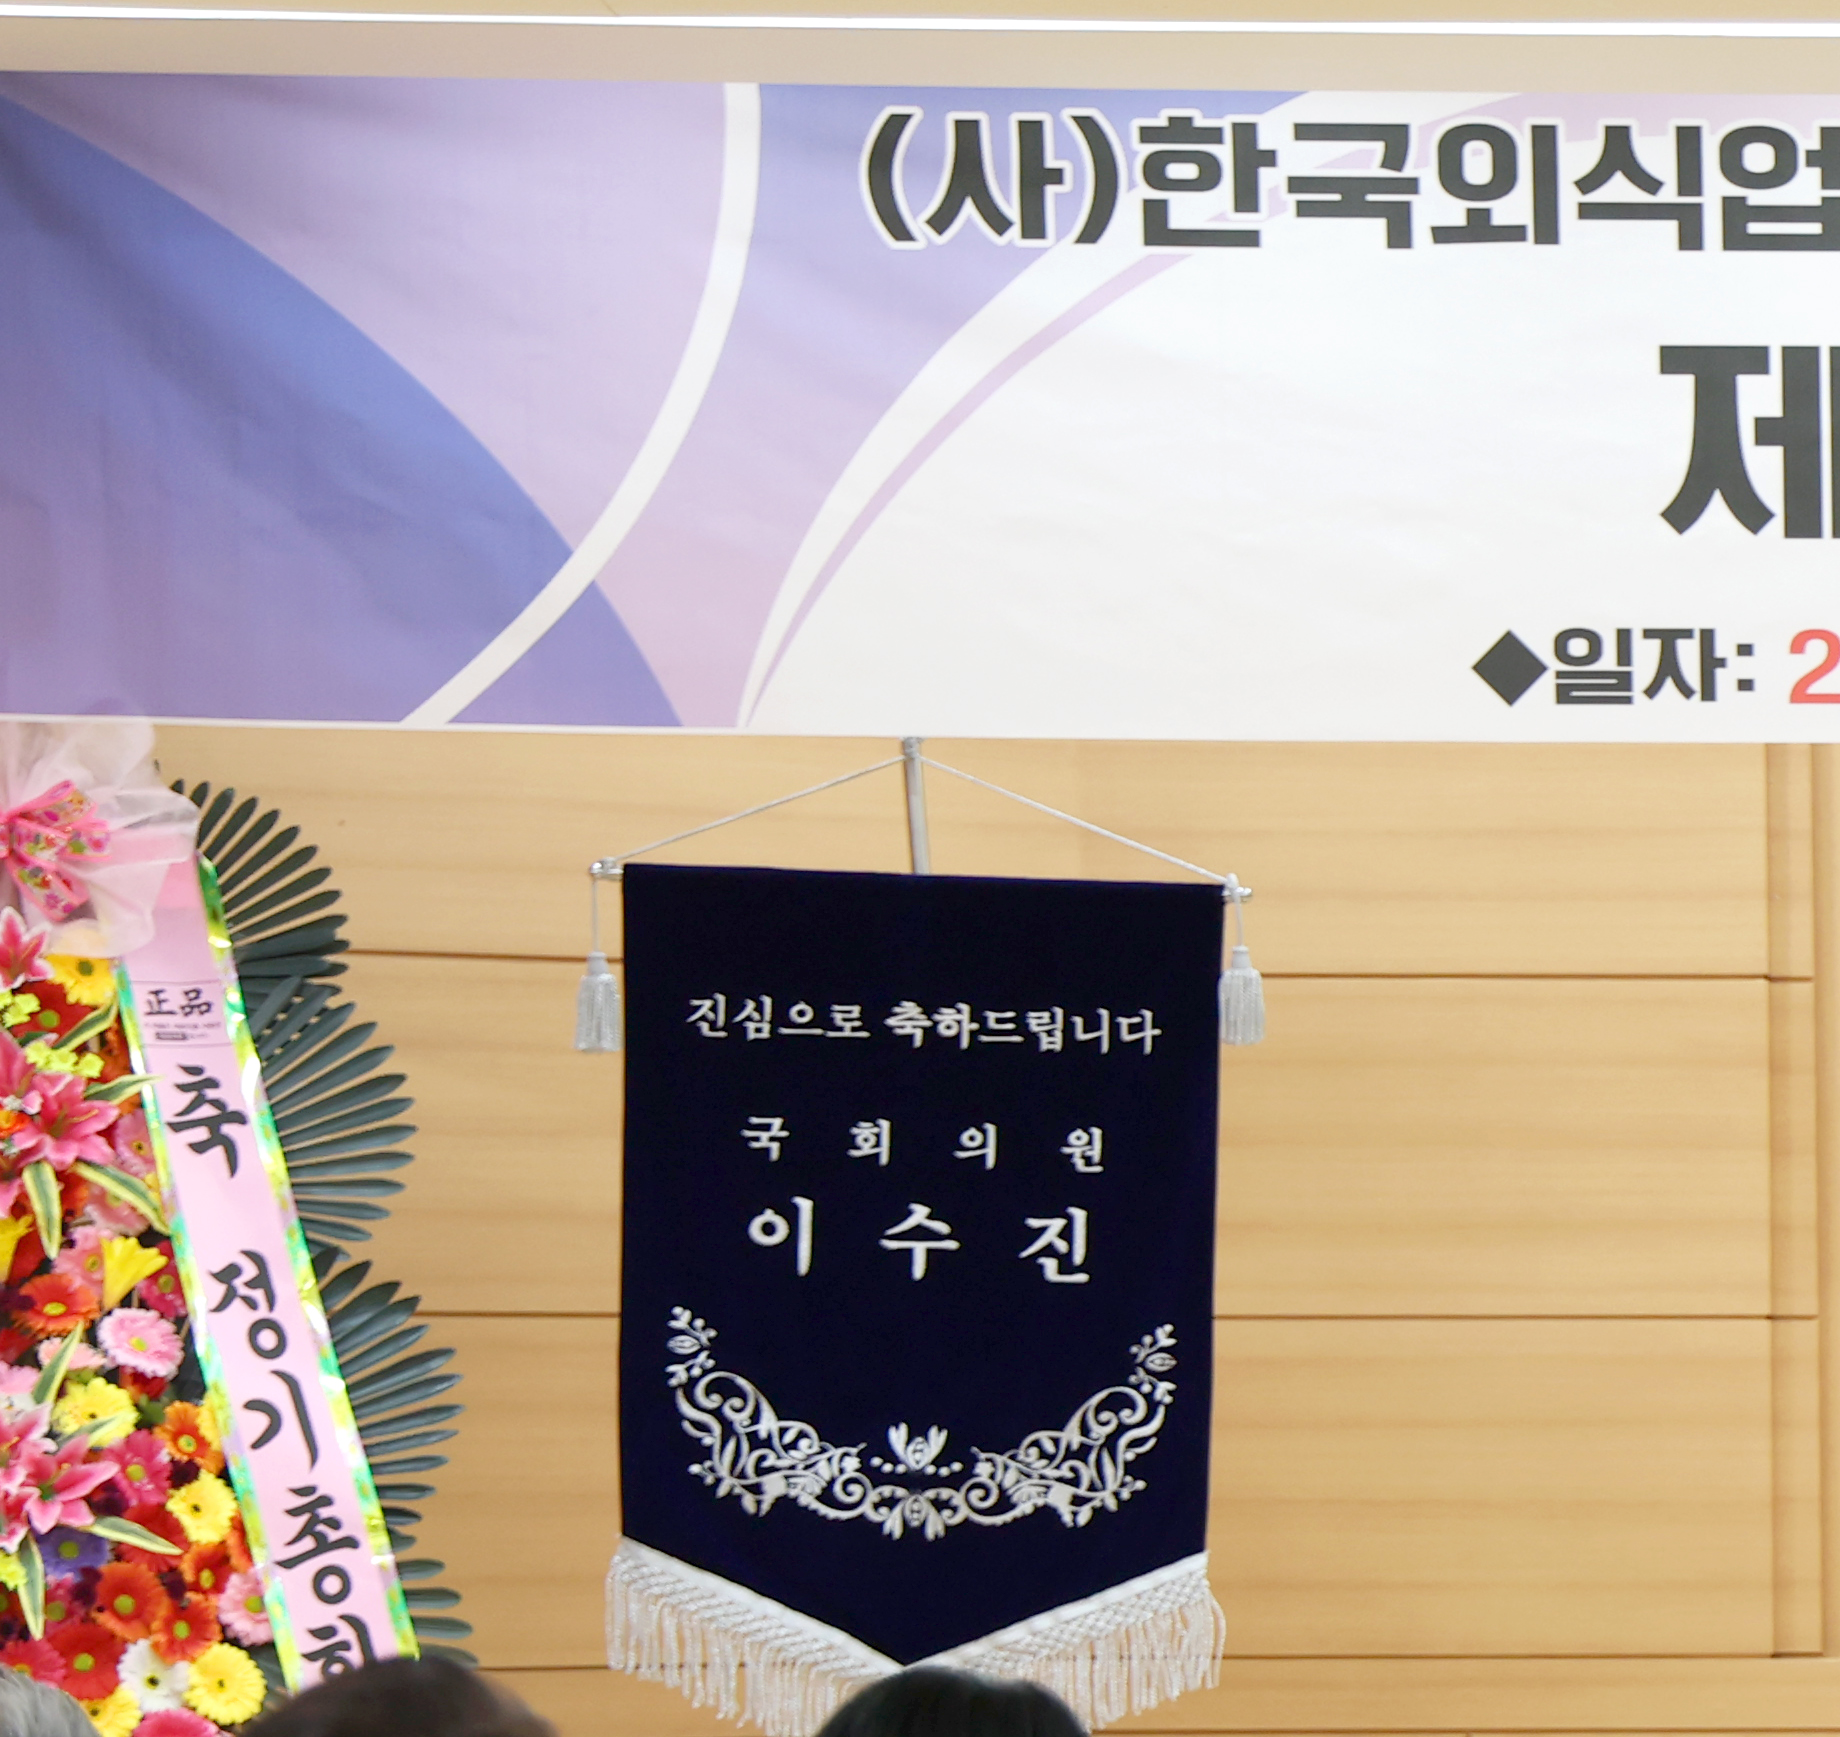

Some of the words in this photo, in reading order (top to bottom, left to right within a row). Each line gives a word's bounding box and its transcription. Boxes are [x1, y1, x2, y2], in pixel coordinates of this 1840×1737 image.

[1553, 627, 1756, 706] 일자:
[685, 992, 872, 1041] 진심으로
[882, 1000, 1163, 1055] 축하드립니다
[166, 1064, 248, 1178] 축
